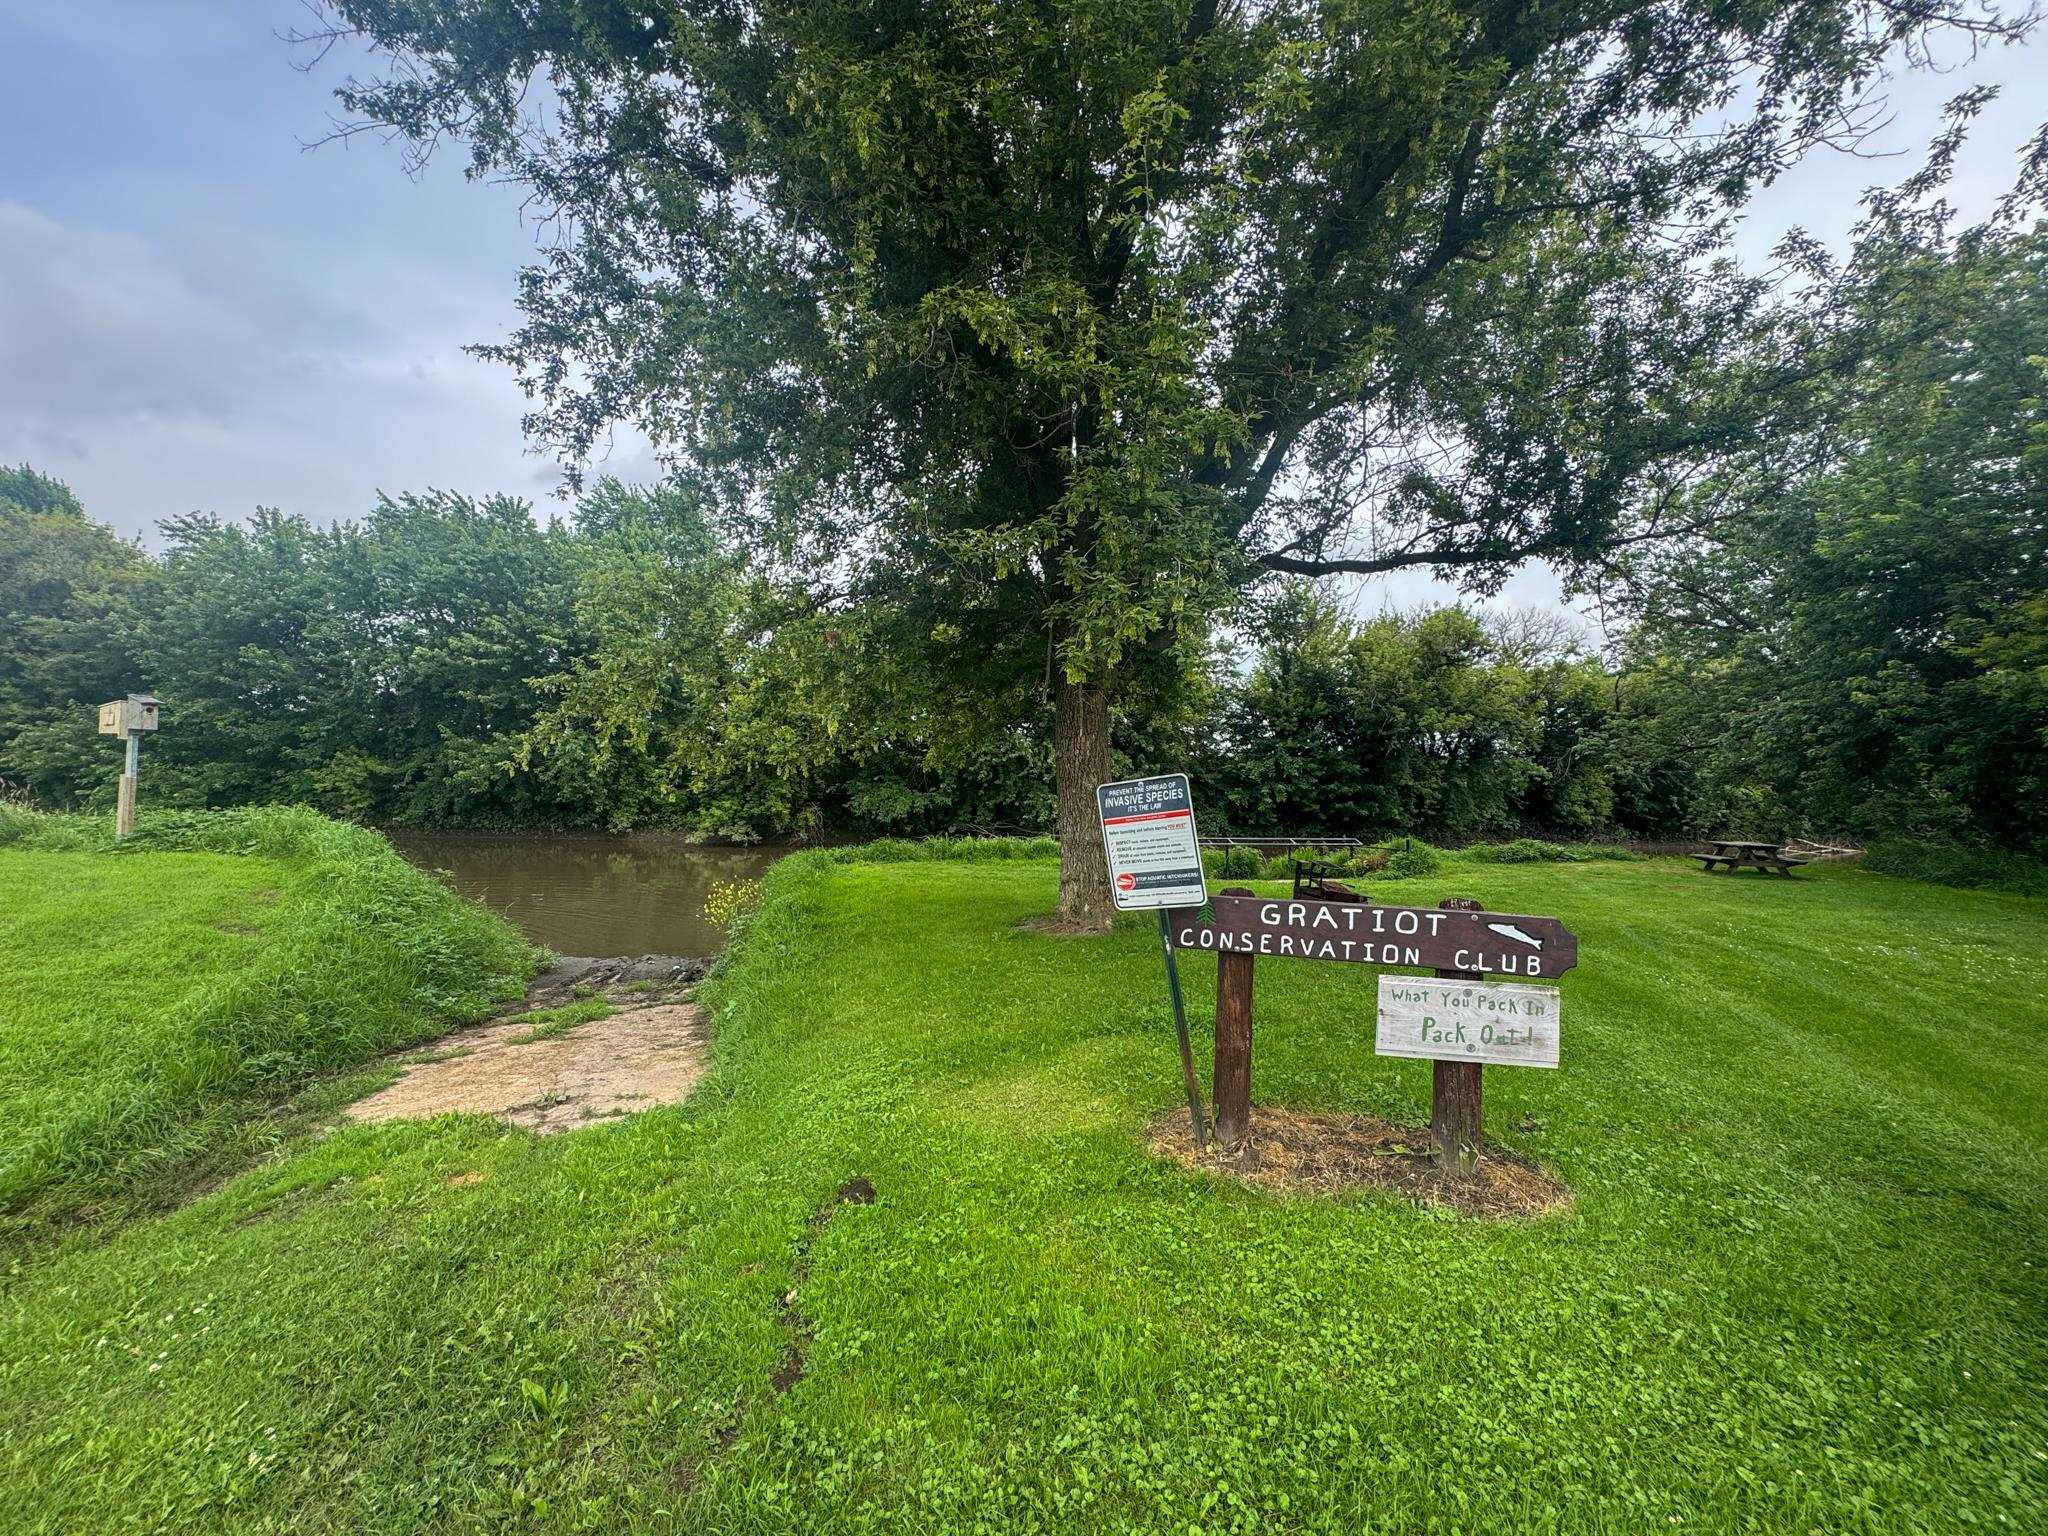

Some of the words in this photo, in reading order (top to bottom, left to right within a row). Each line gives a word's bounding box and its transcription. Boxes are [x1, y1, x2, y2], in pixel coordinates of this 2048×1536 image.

[1105, 793, 1144, 808] INVASIVE
[1145, 788, 1184, 803] SPECIES
[1108, 787, 1133, 797] PREVENT
[1145, 782, 1167, 791] SPREAD
[1168, 781, 1176, 789] OF
[1127, 804, 1138, 812] IT'S
[1139, 803, 1149, 811] THE
[1150, 802, 1162, 810] LAW
[1260, 903, 1447, 937] GRATIOT
[1180, 928, 1420, 965] CONSERVATION
[1454, 949, 1541, 976] CLUB
[1391, 989, 1429, 1003] What
[1441, 992, 1470, 1007] You
[1477, 995, 1518, 1014] Pack
[1526, 1000, 1545, 1016] In
[1421, 1016, 1466, 1043] Pack
